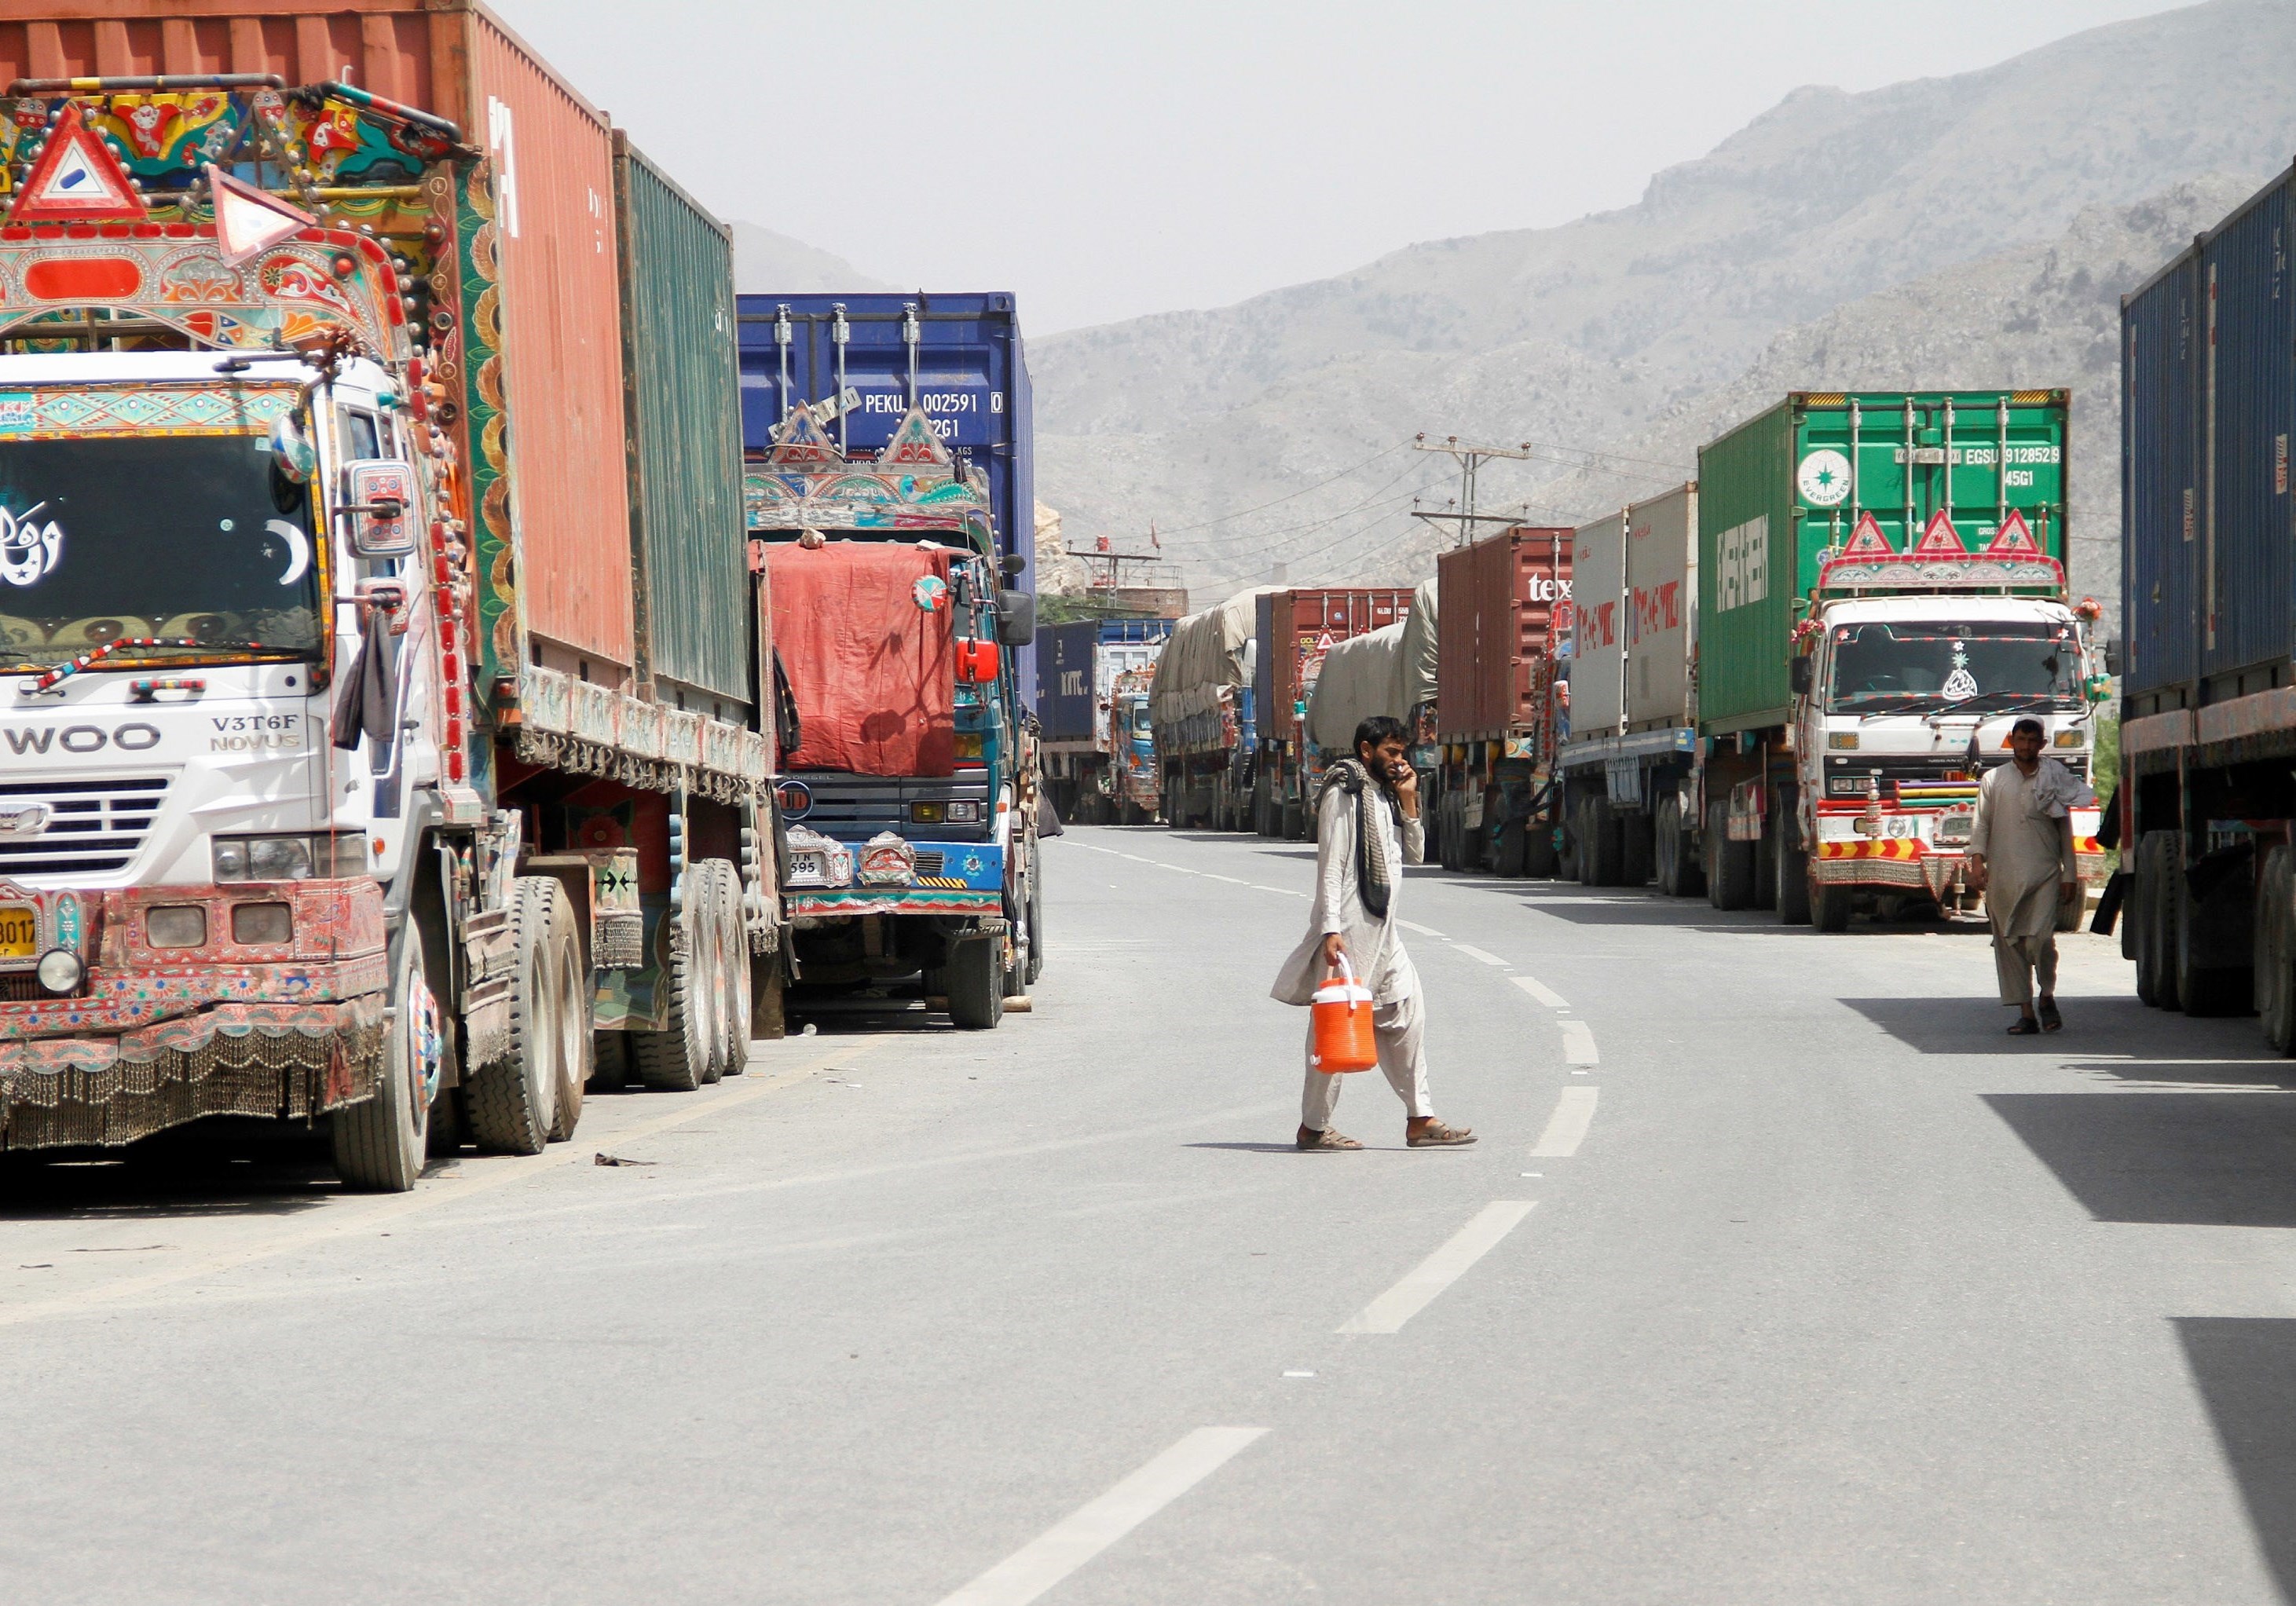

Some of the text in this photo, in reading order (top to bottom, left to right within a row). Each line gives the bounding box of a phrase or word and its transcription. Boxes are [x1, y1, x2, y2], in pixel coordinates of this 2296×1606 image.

[866, 394, 903, 413] PEKU
[923, 393, 976, 412] 002591
[931, 419, 958, 438] 2G1
[1966, 448, 1998, 465] EGSU
[2005, 447, 2050, 463] 912852
[2005, 470, 2033, 486] 45G1
[1803, 479, 1849, 502] EVERGREEN
[1528, 572, 1573, 602] tex
[211, 714, 298, 732] V3T6F
[3, 723, 161, 755] WOO
[210, 733, 300, 751] NOVUS
